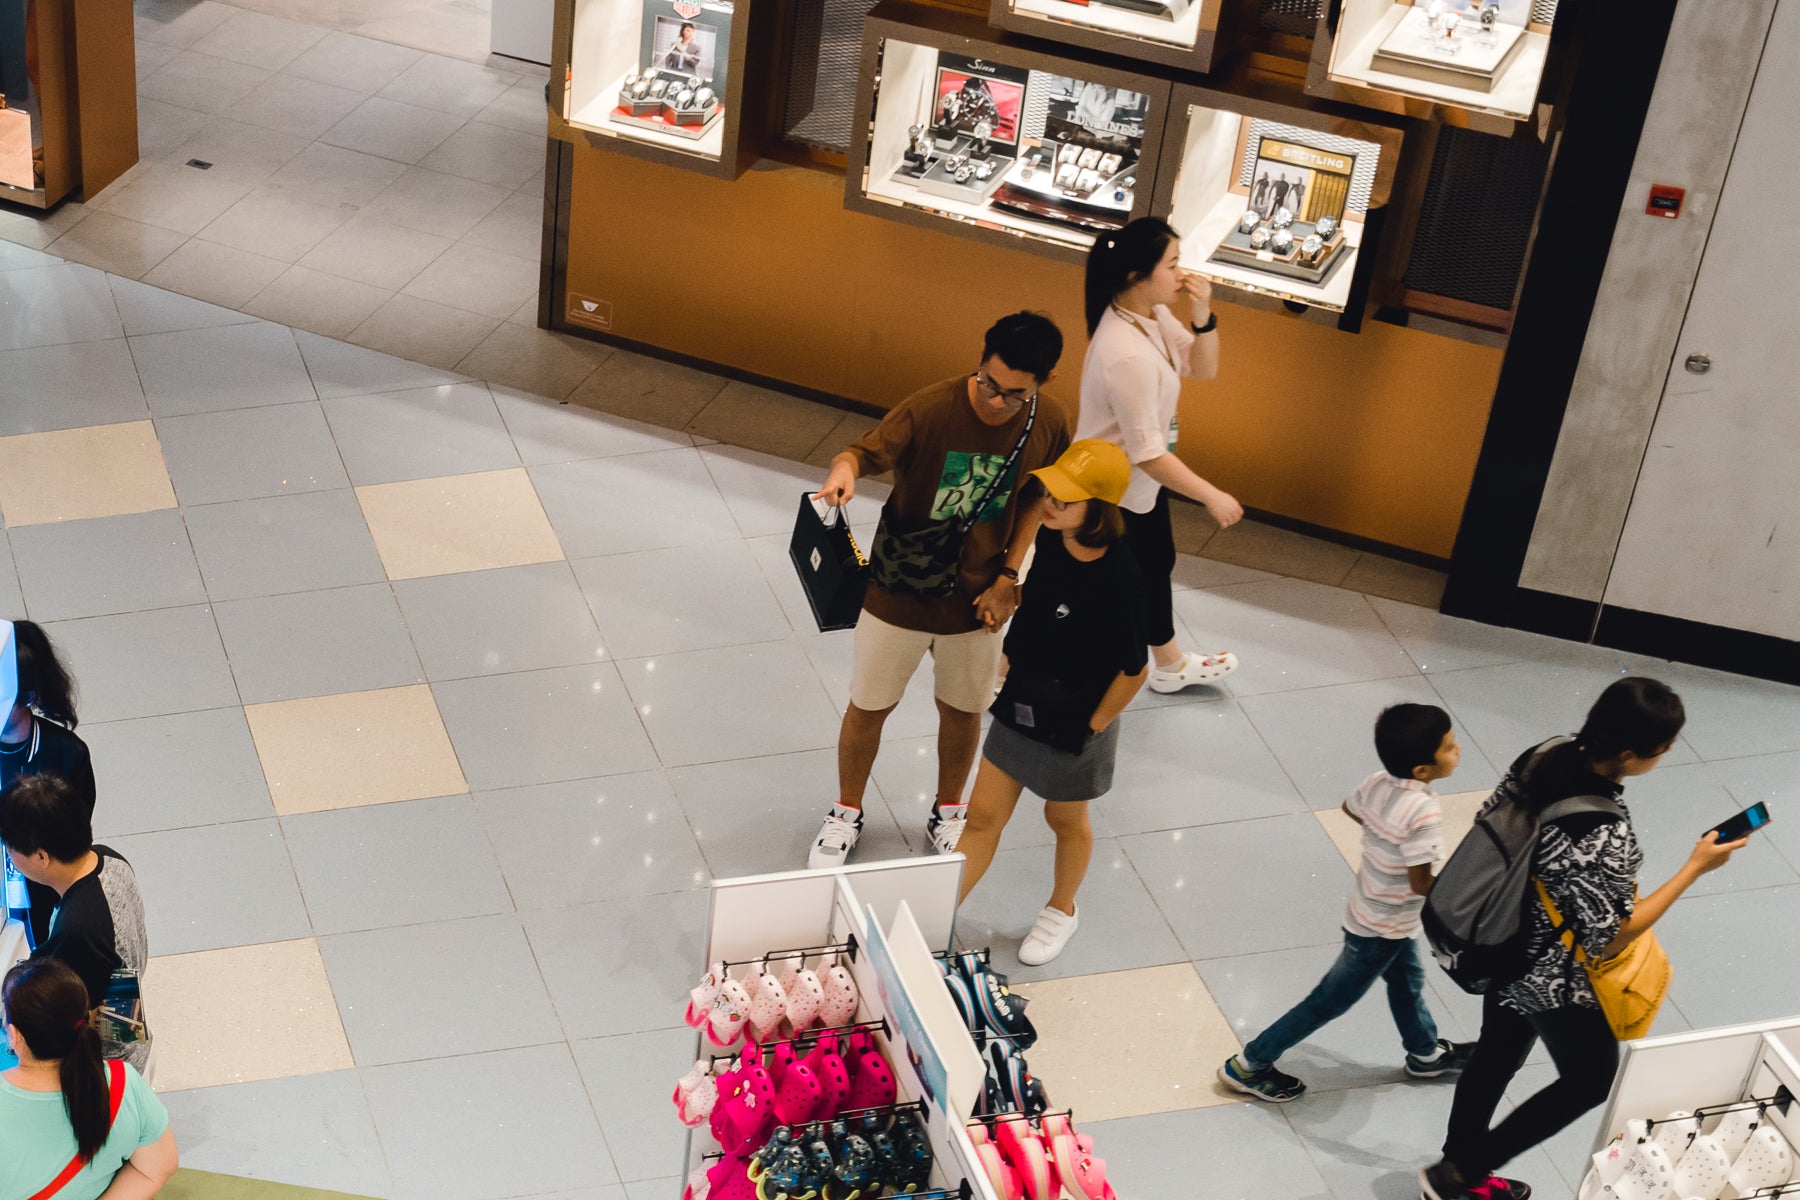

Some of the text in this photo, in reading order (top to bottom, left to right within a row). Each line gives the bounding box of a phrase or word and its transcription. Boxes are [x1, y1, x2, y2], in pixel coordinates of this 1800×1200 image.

[967, 58, 997, 74] Sinn
[1065, 110, 1139, 137] LONINES
[1281, 148, 1345, 169] BREITLING
